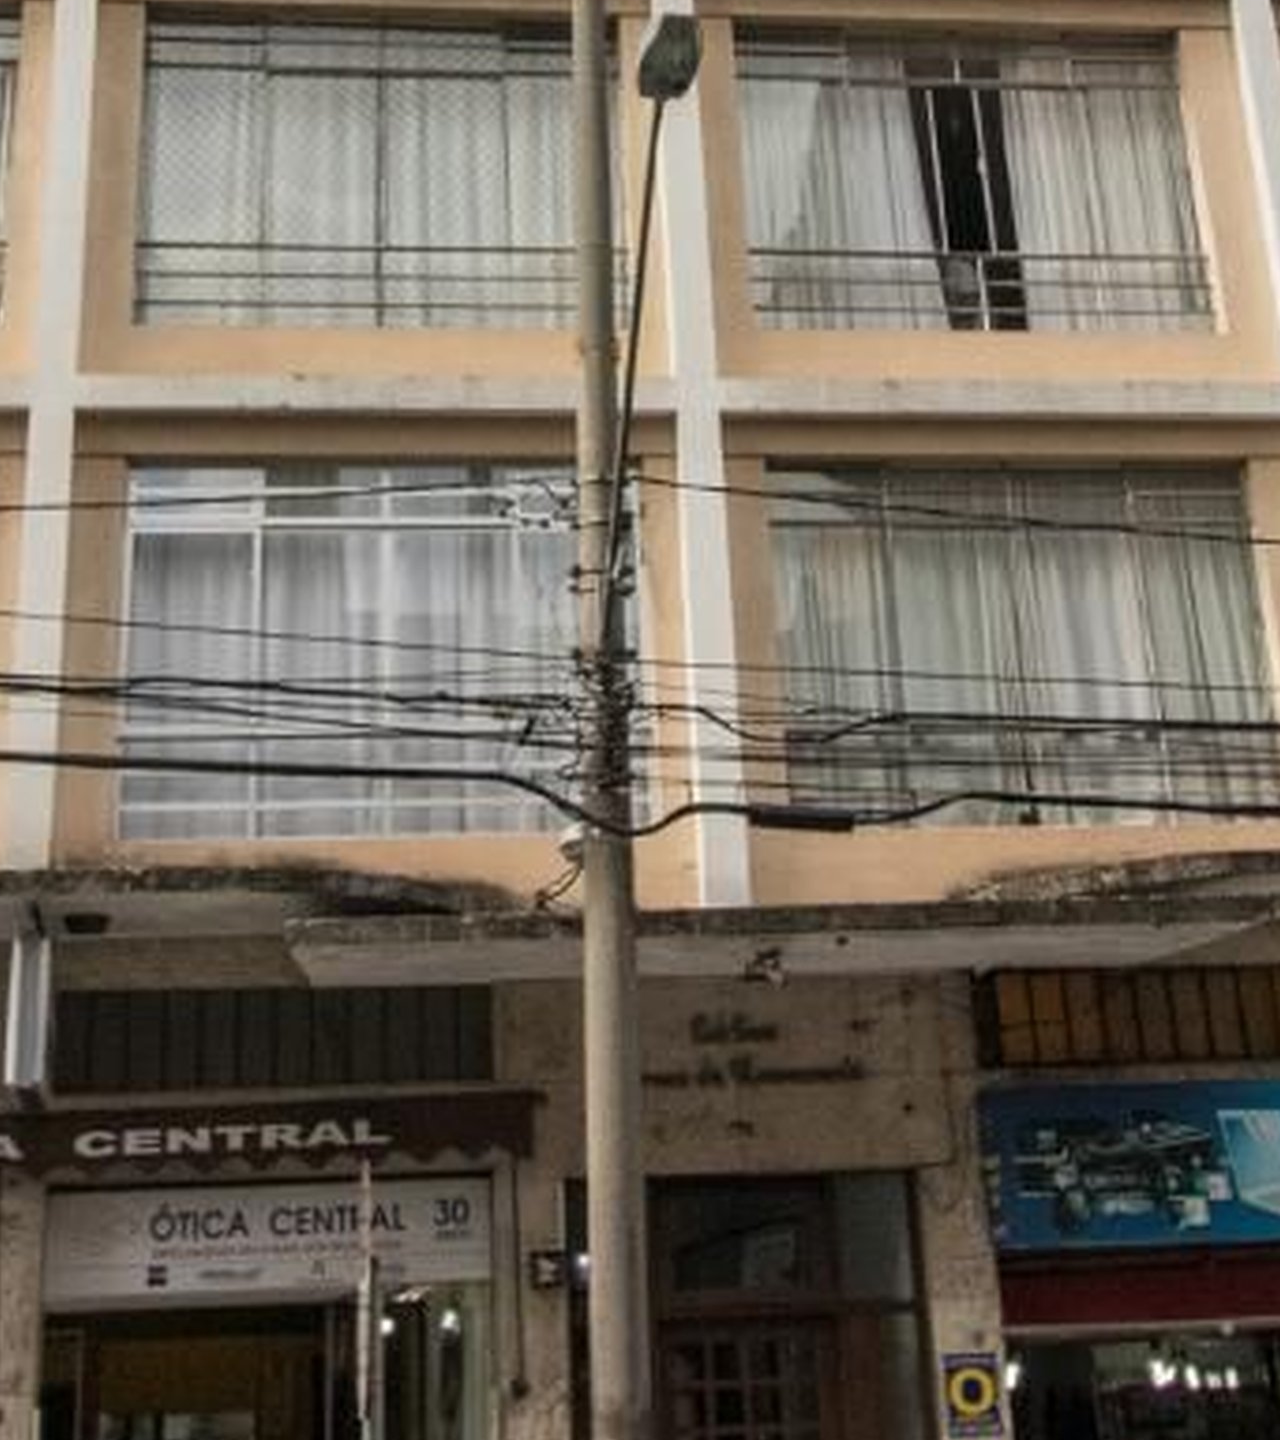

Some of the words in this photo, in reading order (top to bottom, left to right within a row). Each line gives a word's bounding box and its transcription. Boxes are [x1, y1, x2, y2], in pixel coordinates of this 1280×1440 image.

[73, 1119, 393, 1159] CENTRAL
[149, 1201, 250, 1243] ÓTICA
[433, 1198, 470, 1226] 30
